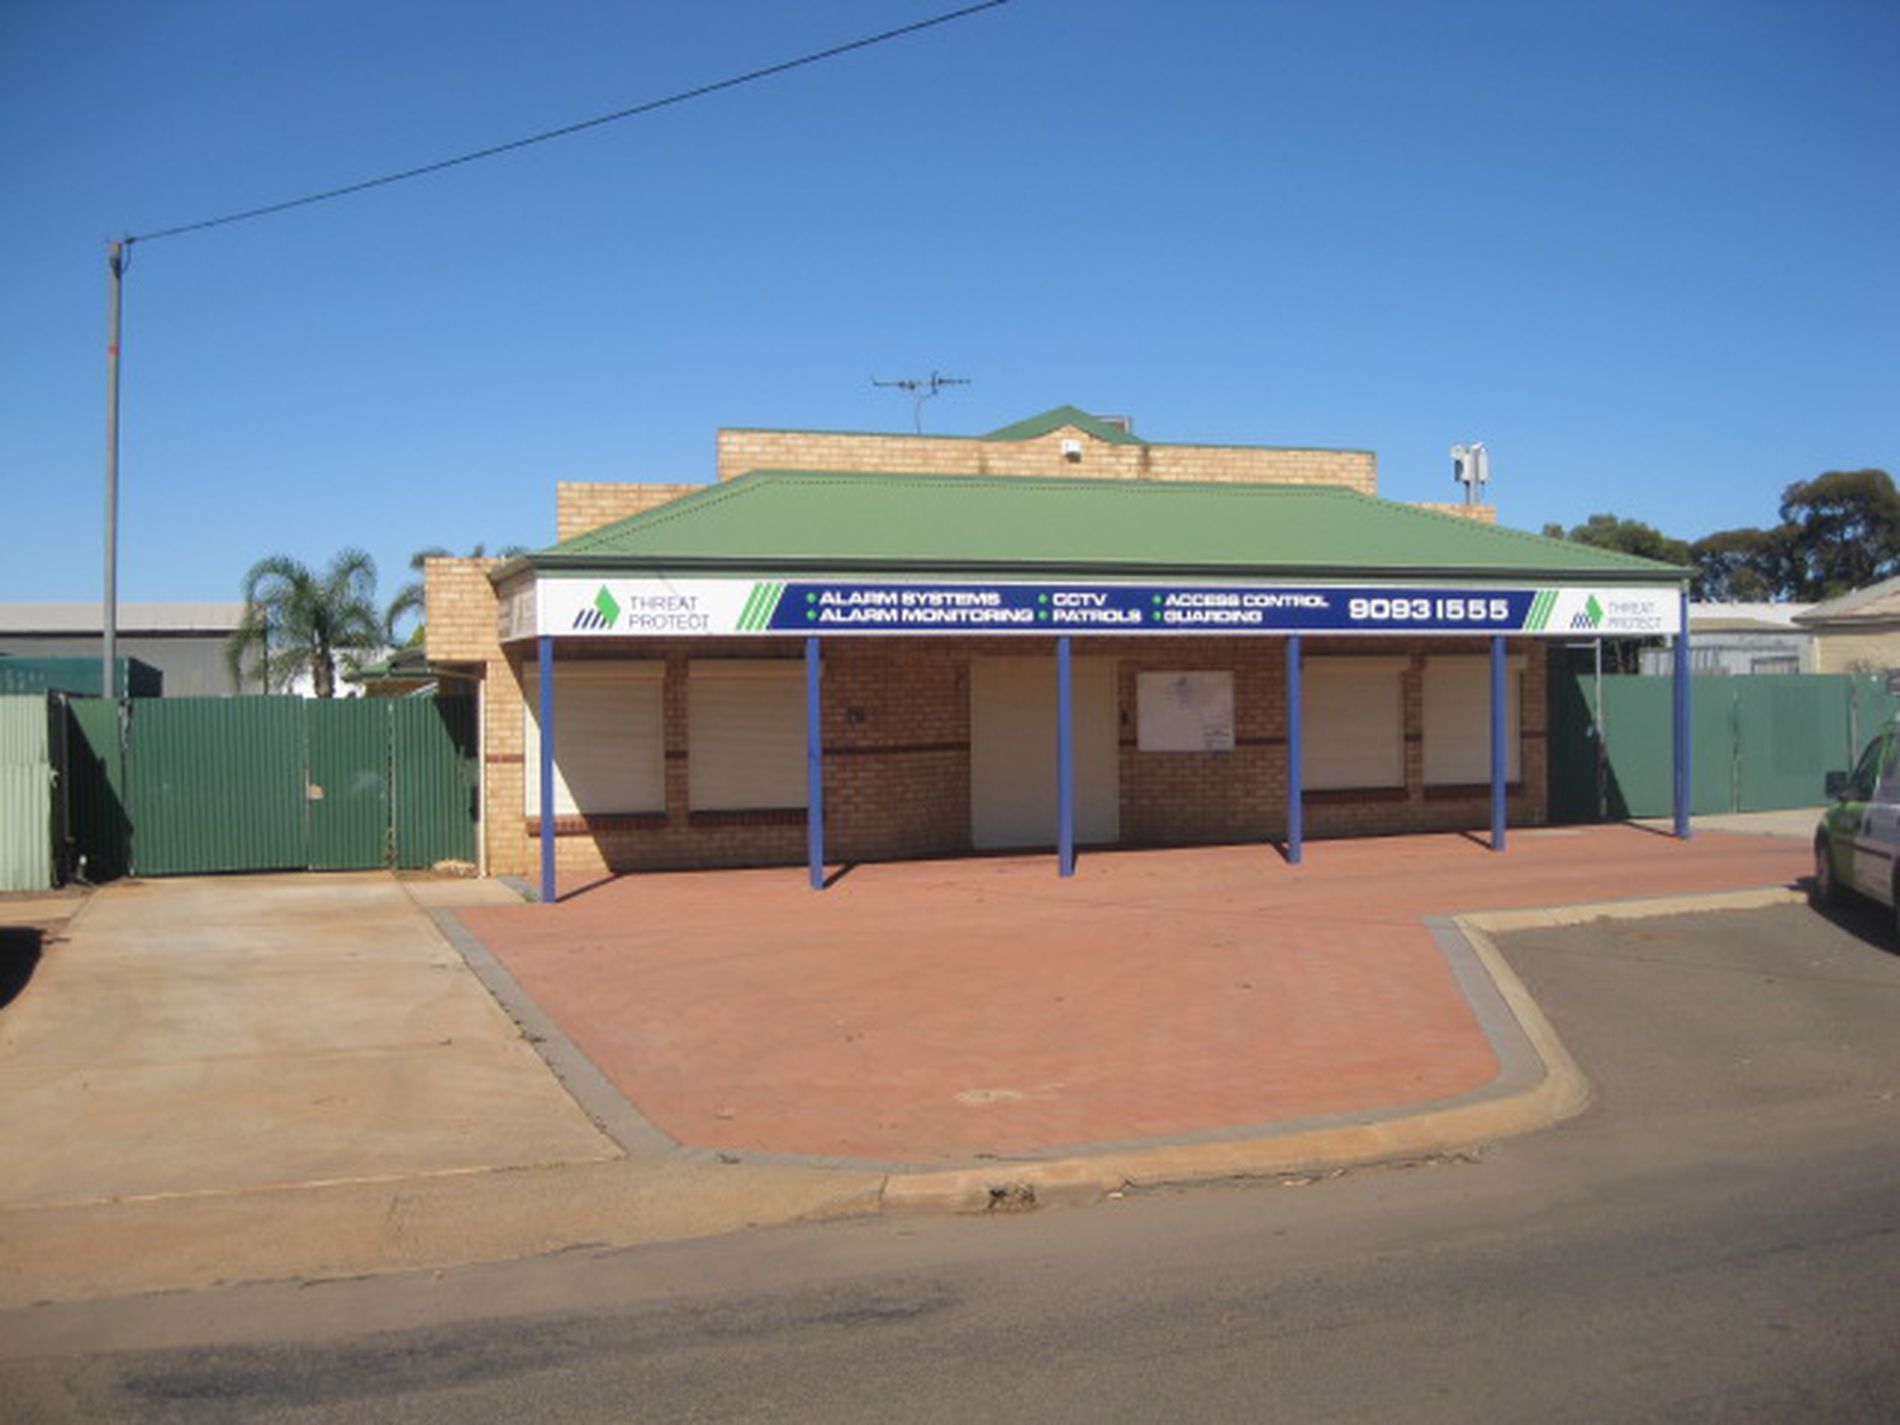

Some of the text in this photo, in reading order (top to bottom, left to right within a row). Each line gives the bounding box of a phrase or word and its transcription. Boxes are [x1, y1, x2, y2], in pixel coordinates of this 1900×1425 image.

[629, 596, 698, 611] THREAT
[819, 592, 1001, 606] ALARM SYSTEMS
[1052, 592, 1108, 606] CCTV
[1165, 593, 1330, 608] ACCESS CONTROL
[628, 614, 710, 630] PROTECT
[819, 608, 1034, 622] ALARM MONITORING
[1052, 608, 1142, 623] PATROLS
[1163, 609, 1263, 623] GUARDING
